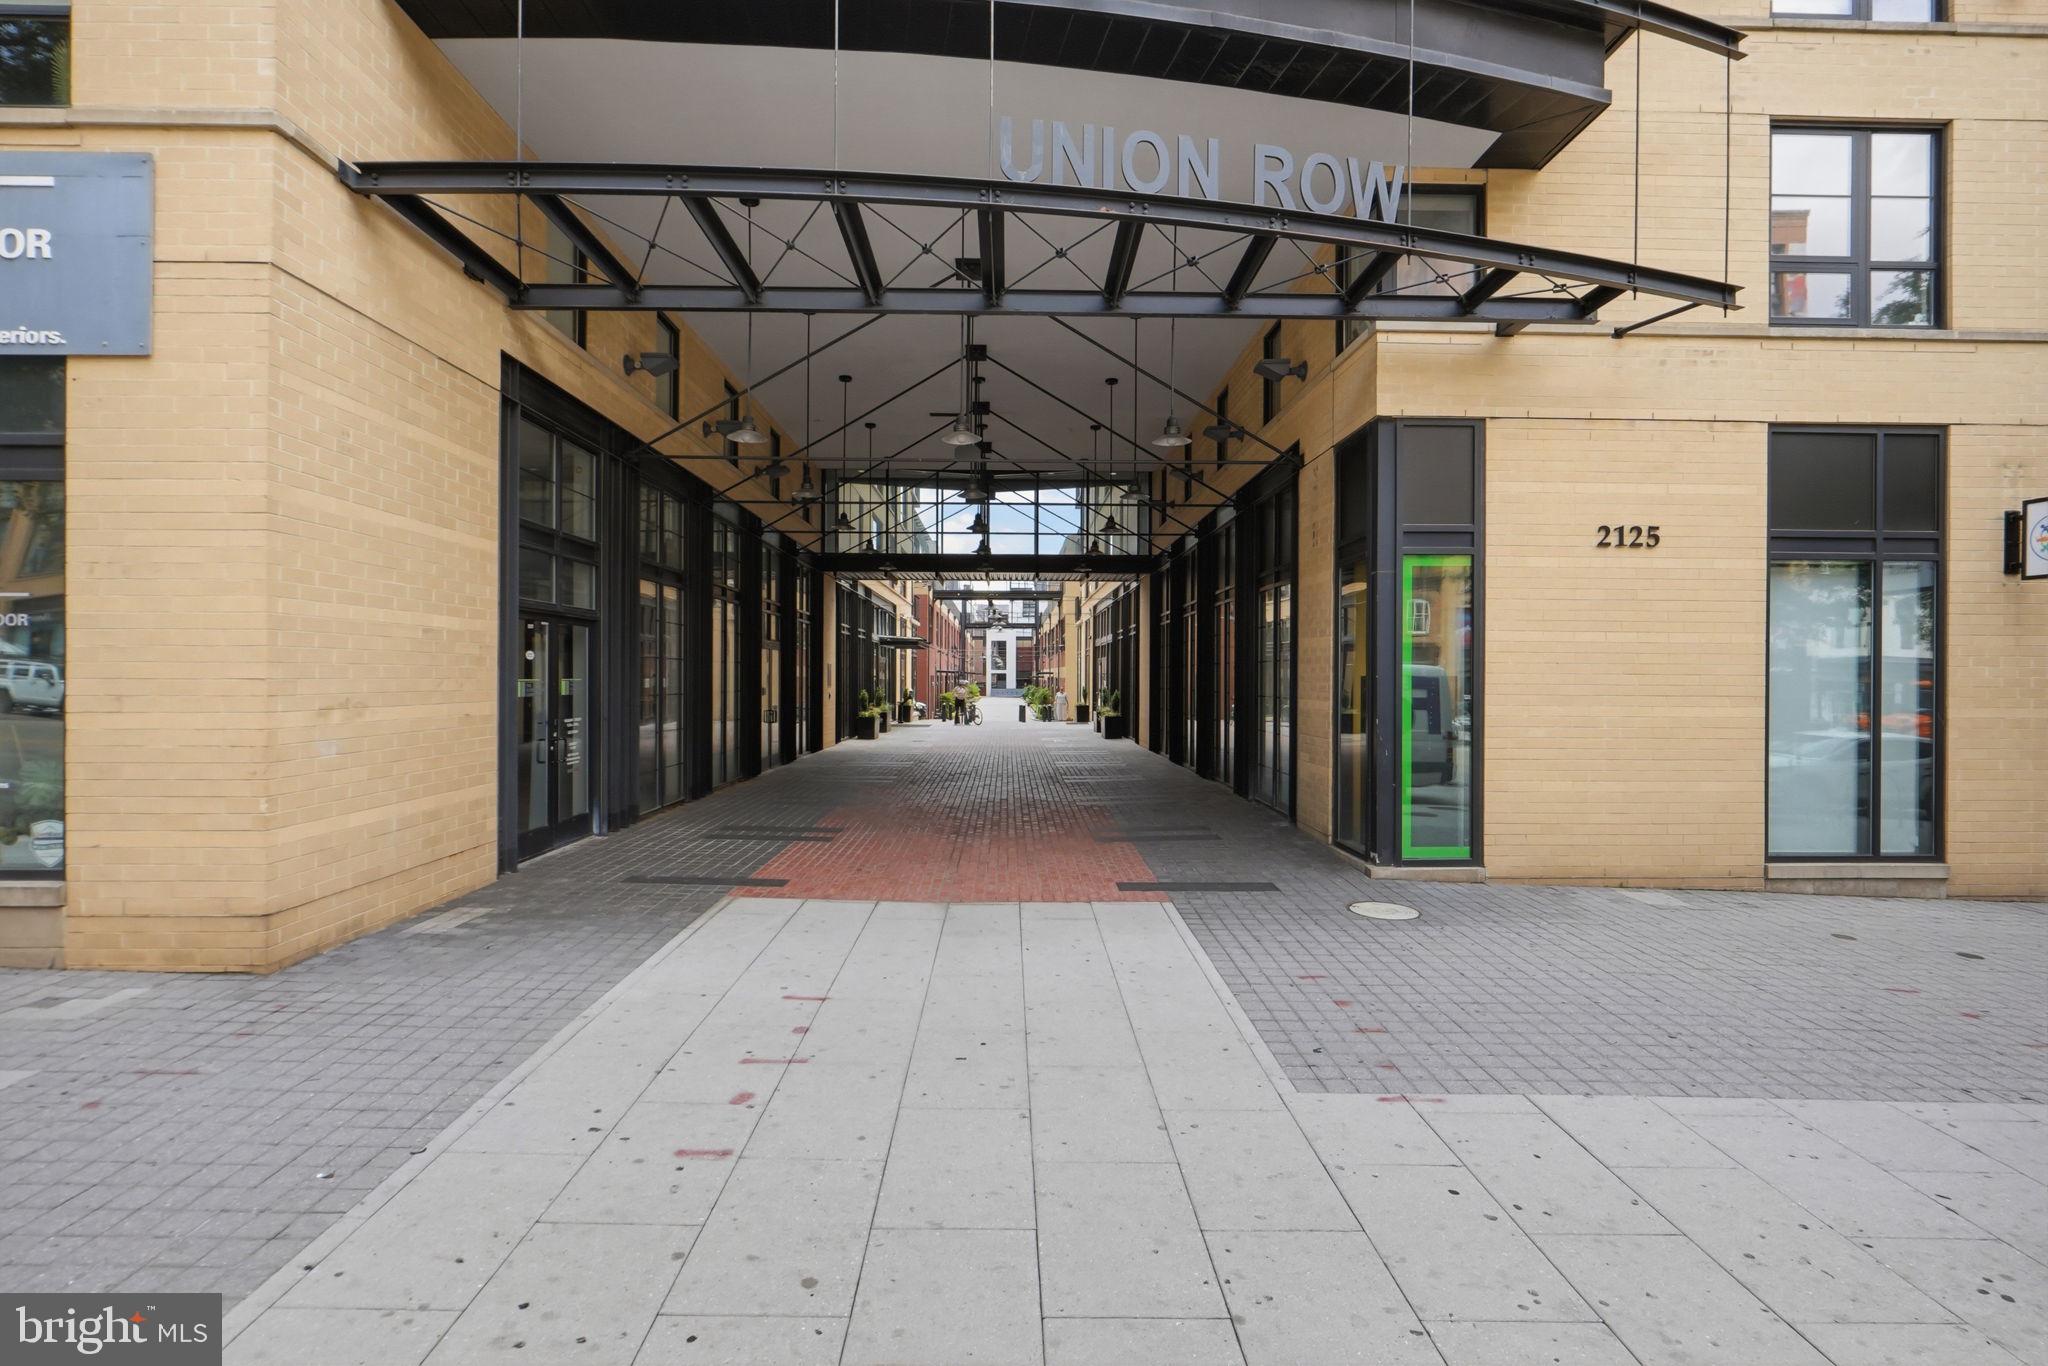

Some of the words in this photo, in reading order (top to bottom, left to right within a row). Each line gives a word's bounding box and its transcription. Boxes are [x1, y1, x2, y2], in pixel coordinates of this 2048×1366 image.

[1001, 116, 1220, 200] UNION
[1253, 143, 1405, 224] ROW
[0, 326, 67, 344] eriors.
[1596, 525, 1661, 548] 2125
